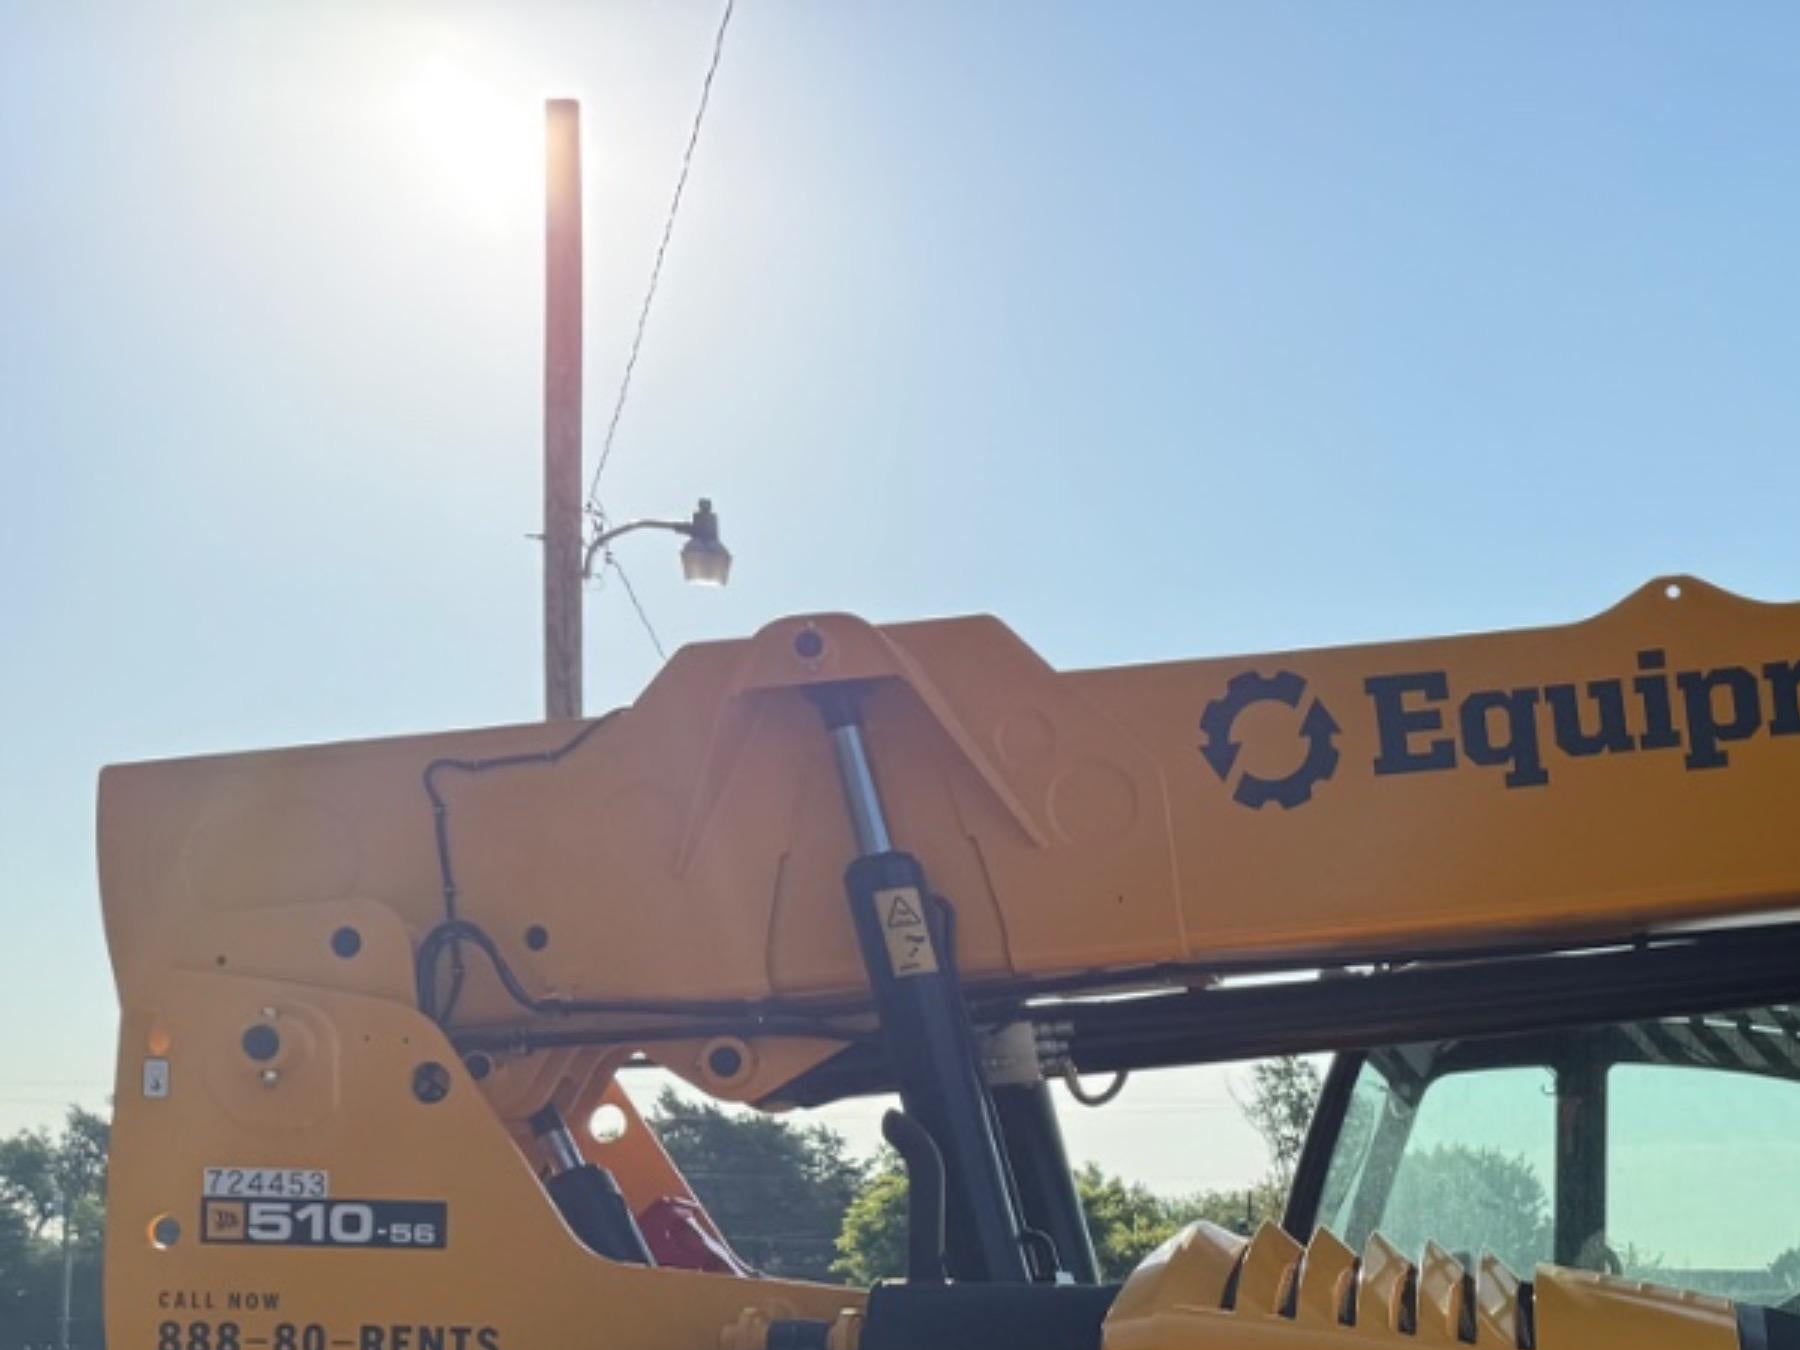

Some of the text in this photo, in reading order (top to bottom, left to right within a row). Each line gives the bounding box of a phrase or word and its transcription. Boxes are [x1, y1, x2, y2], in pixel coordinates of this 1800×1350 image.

[207, 1169, 325, 1196] 724453
[248, 1202, 436, 1243] 510-56
[158, 1292, 280, 1309] CALL NOW
